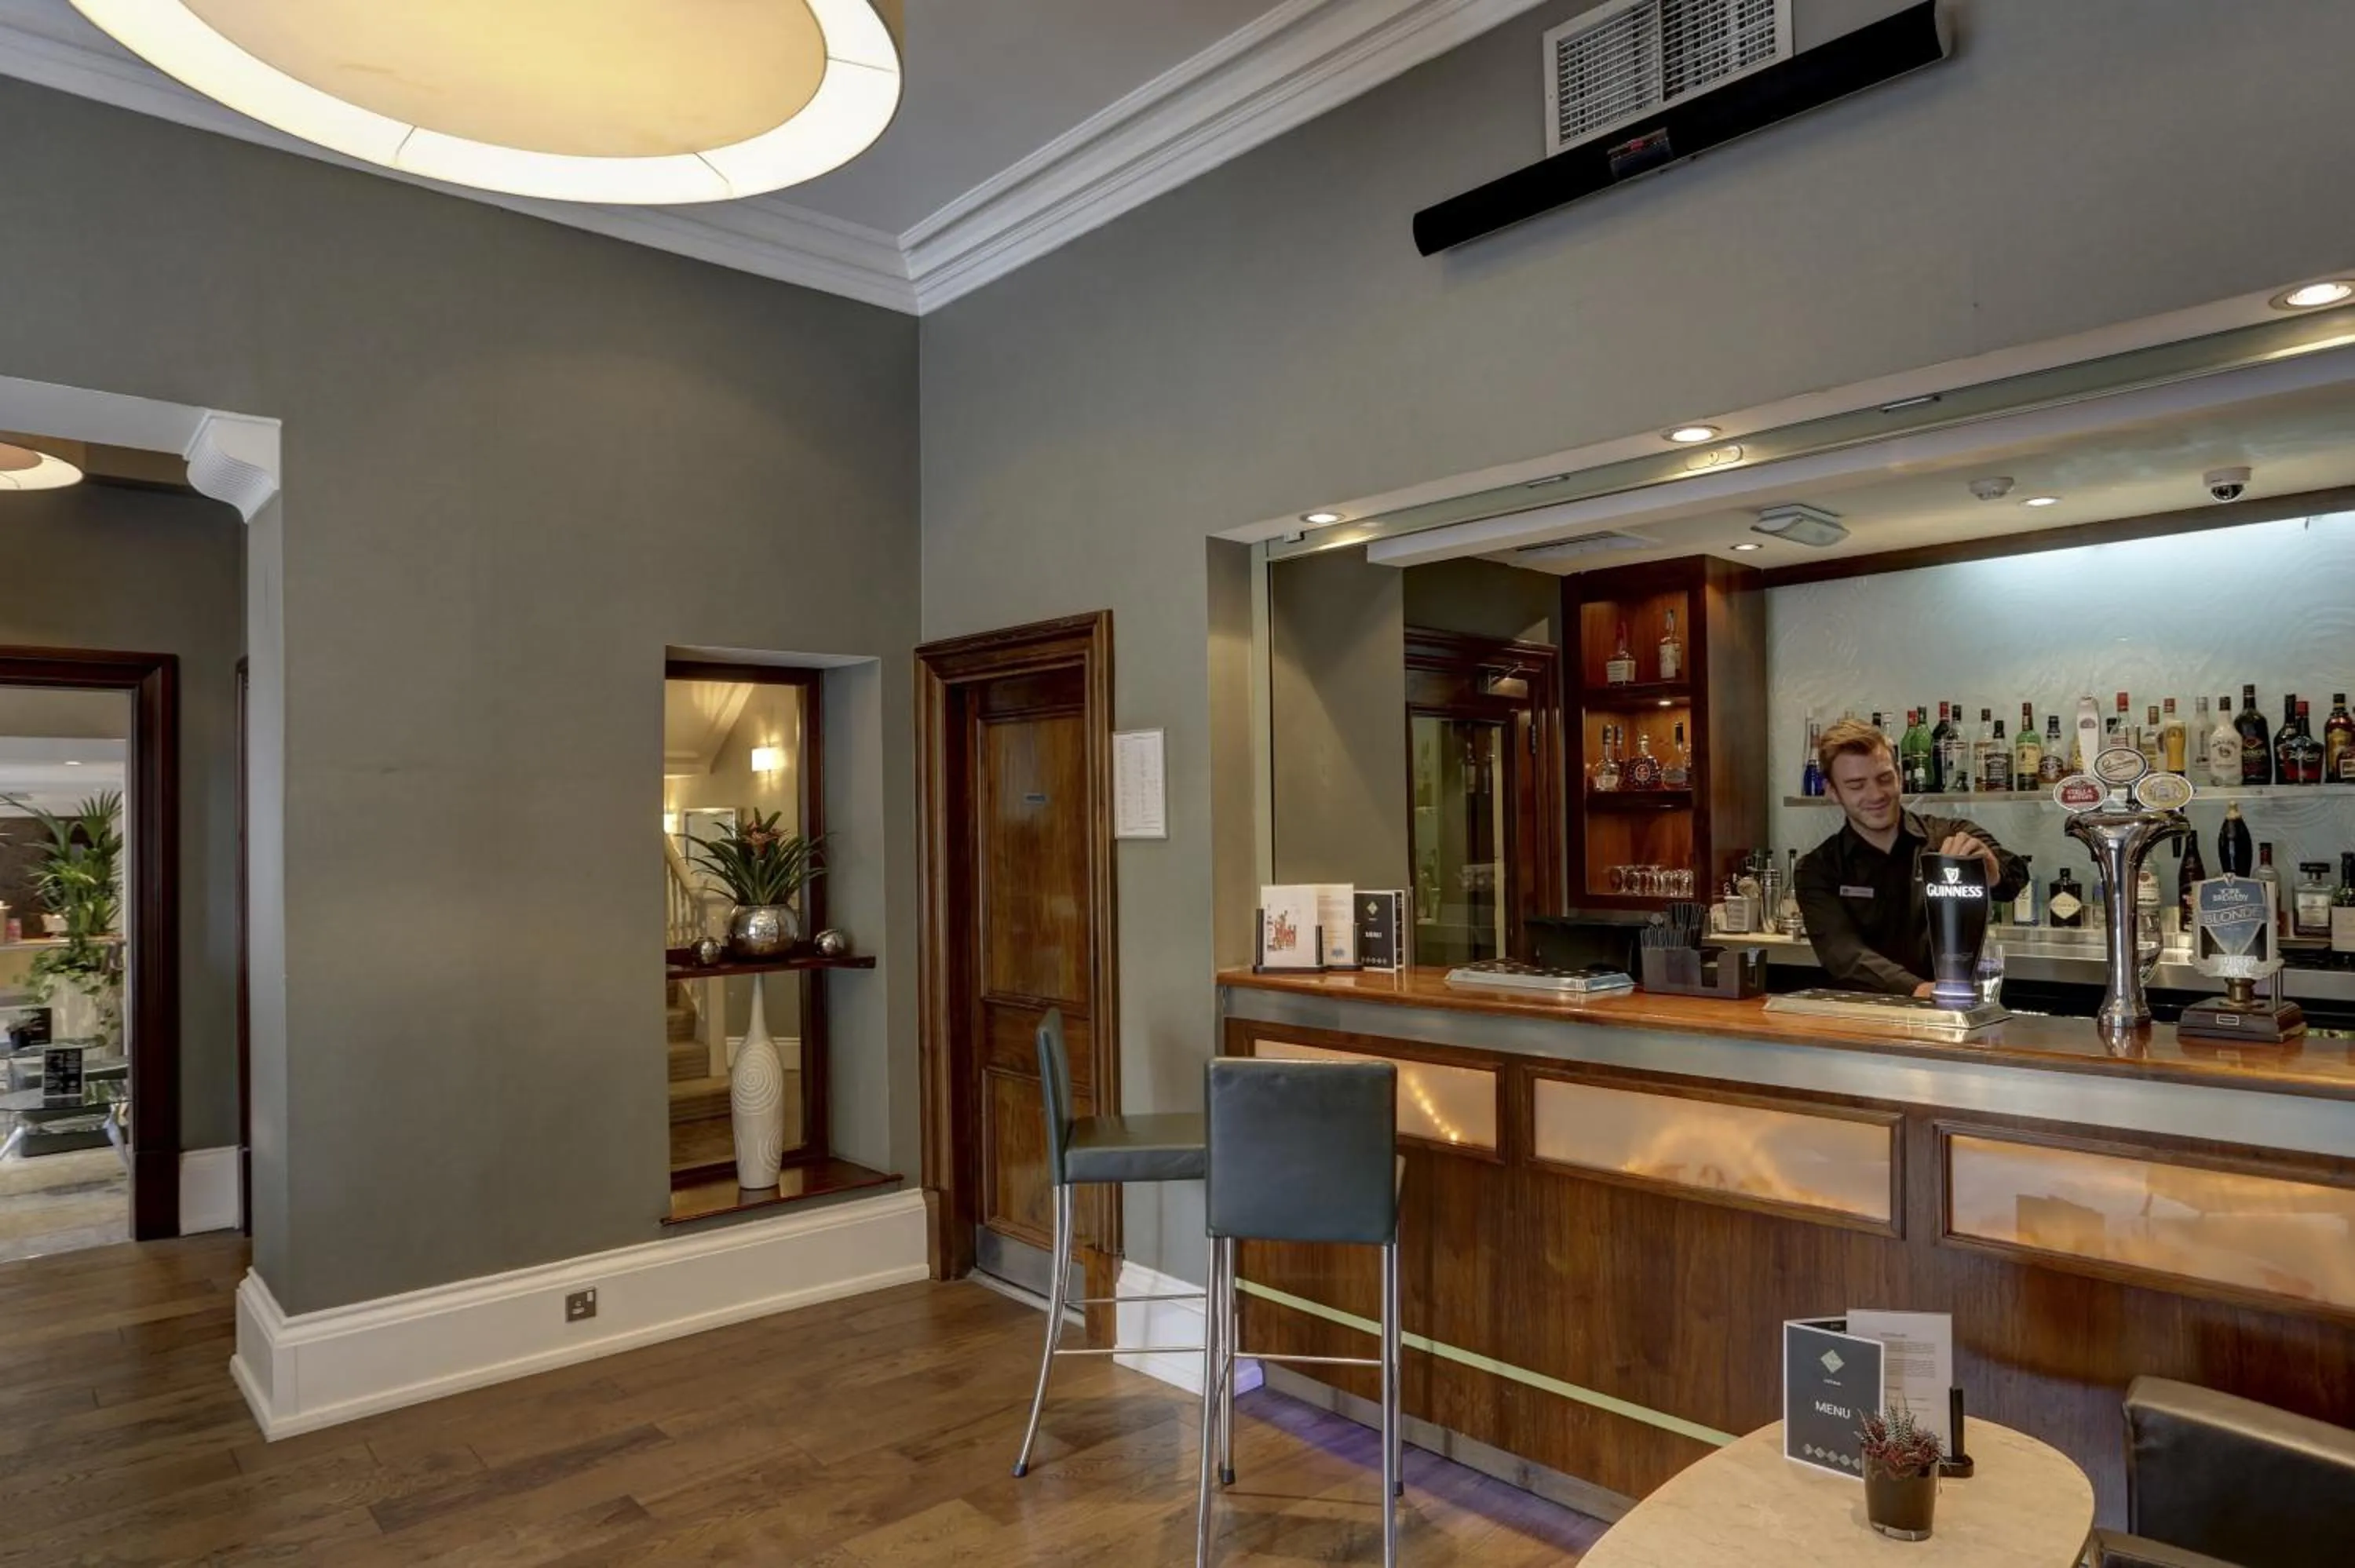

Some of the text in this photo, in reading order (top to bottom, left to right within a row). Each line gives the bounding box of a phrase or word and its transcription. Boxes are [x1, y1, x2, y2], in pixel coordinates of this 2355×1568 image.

[1926, 883, 1984, 897] GUINNESS
[2204, 907, 2264, 924] BLONDE
[1816, 1400, 1850, 1419] MENU
